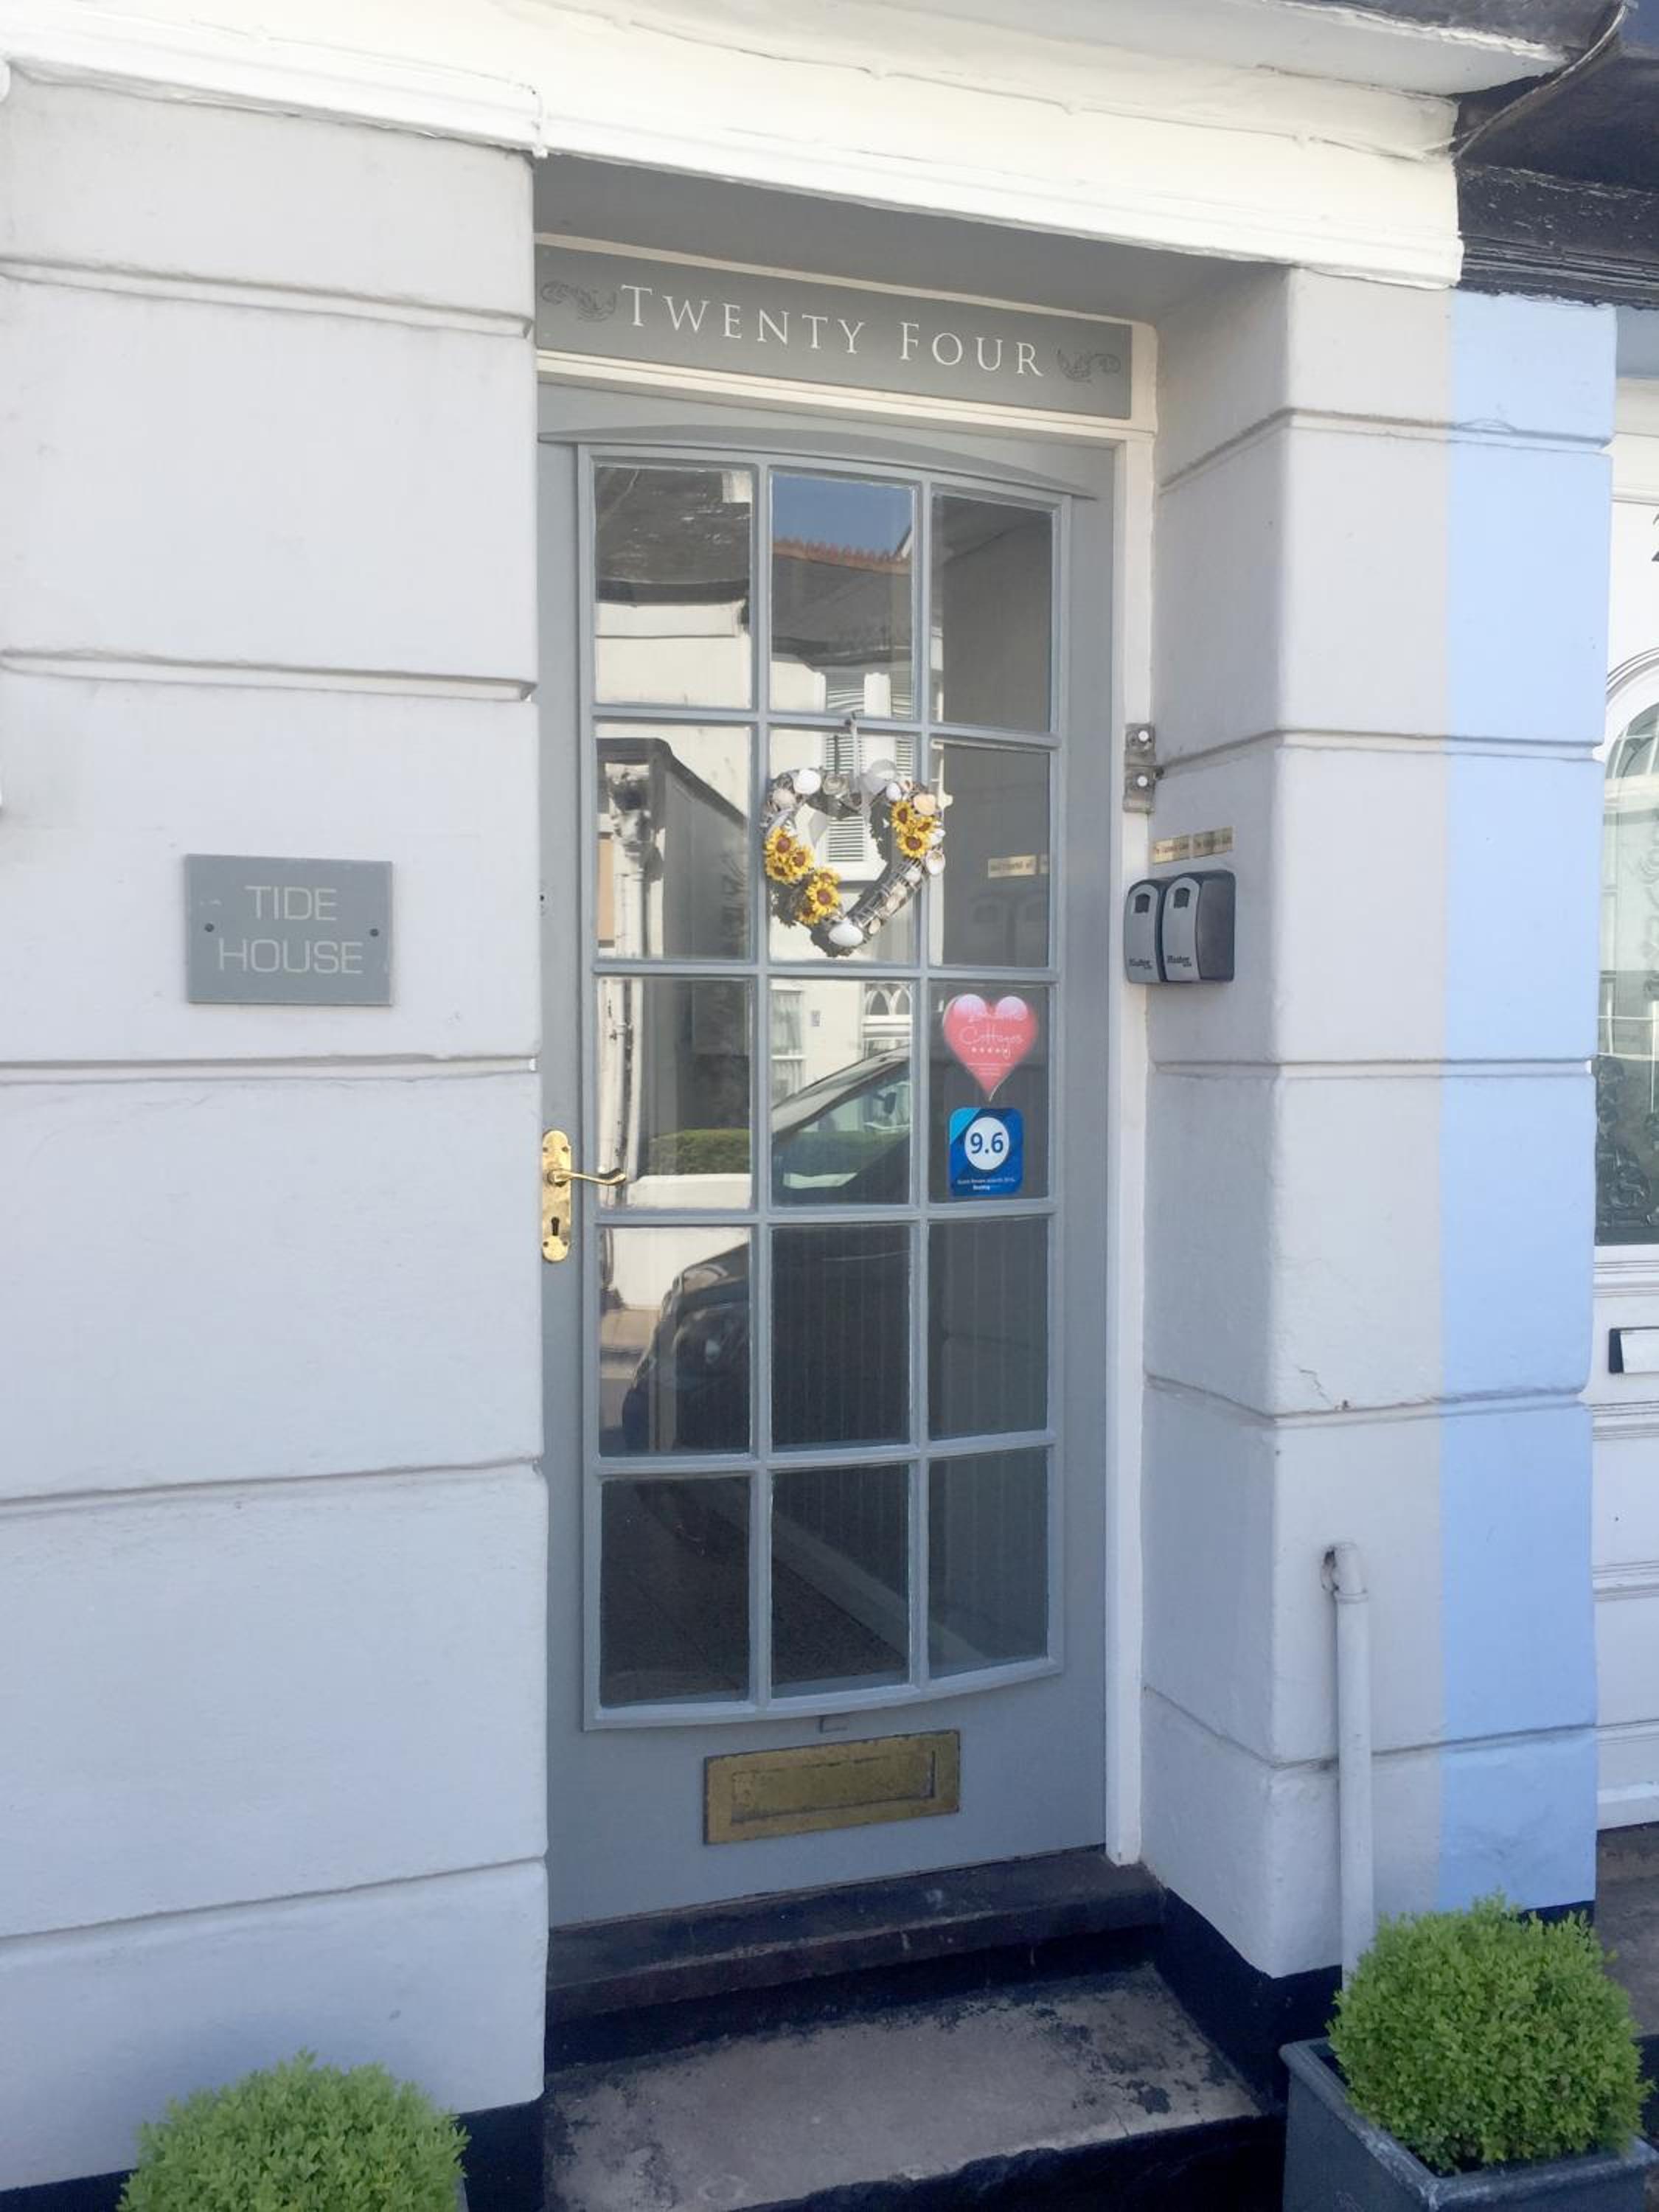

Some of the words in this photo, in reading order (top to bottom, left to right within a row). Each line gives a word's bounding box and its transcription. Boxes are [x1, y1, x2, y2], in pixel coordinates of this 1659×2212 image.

[244, 886, 338, 921] TIDE
[218, 938, 364, 974] HOUSE
[970, 1132, 1004, 1155] 9.6
